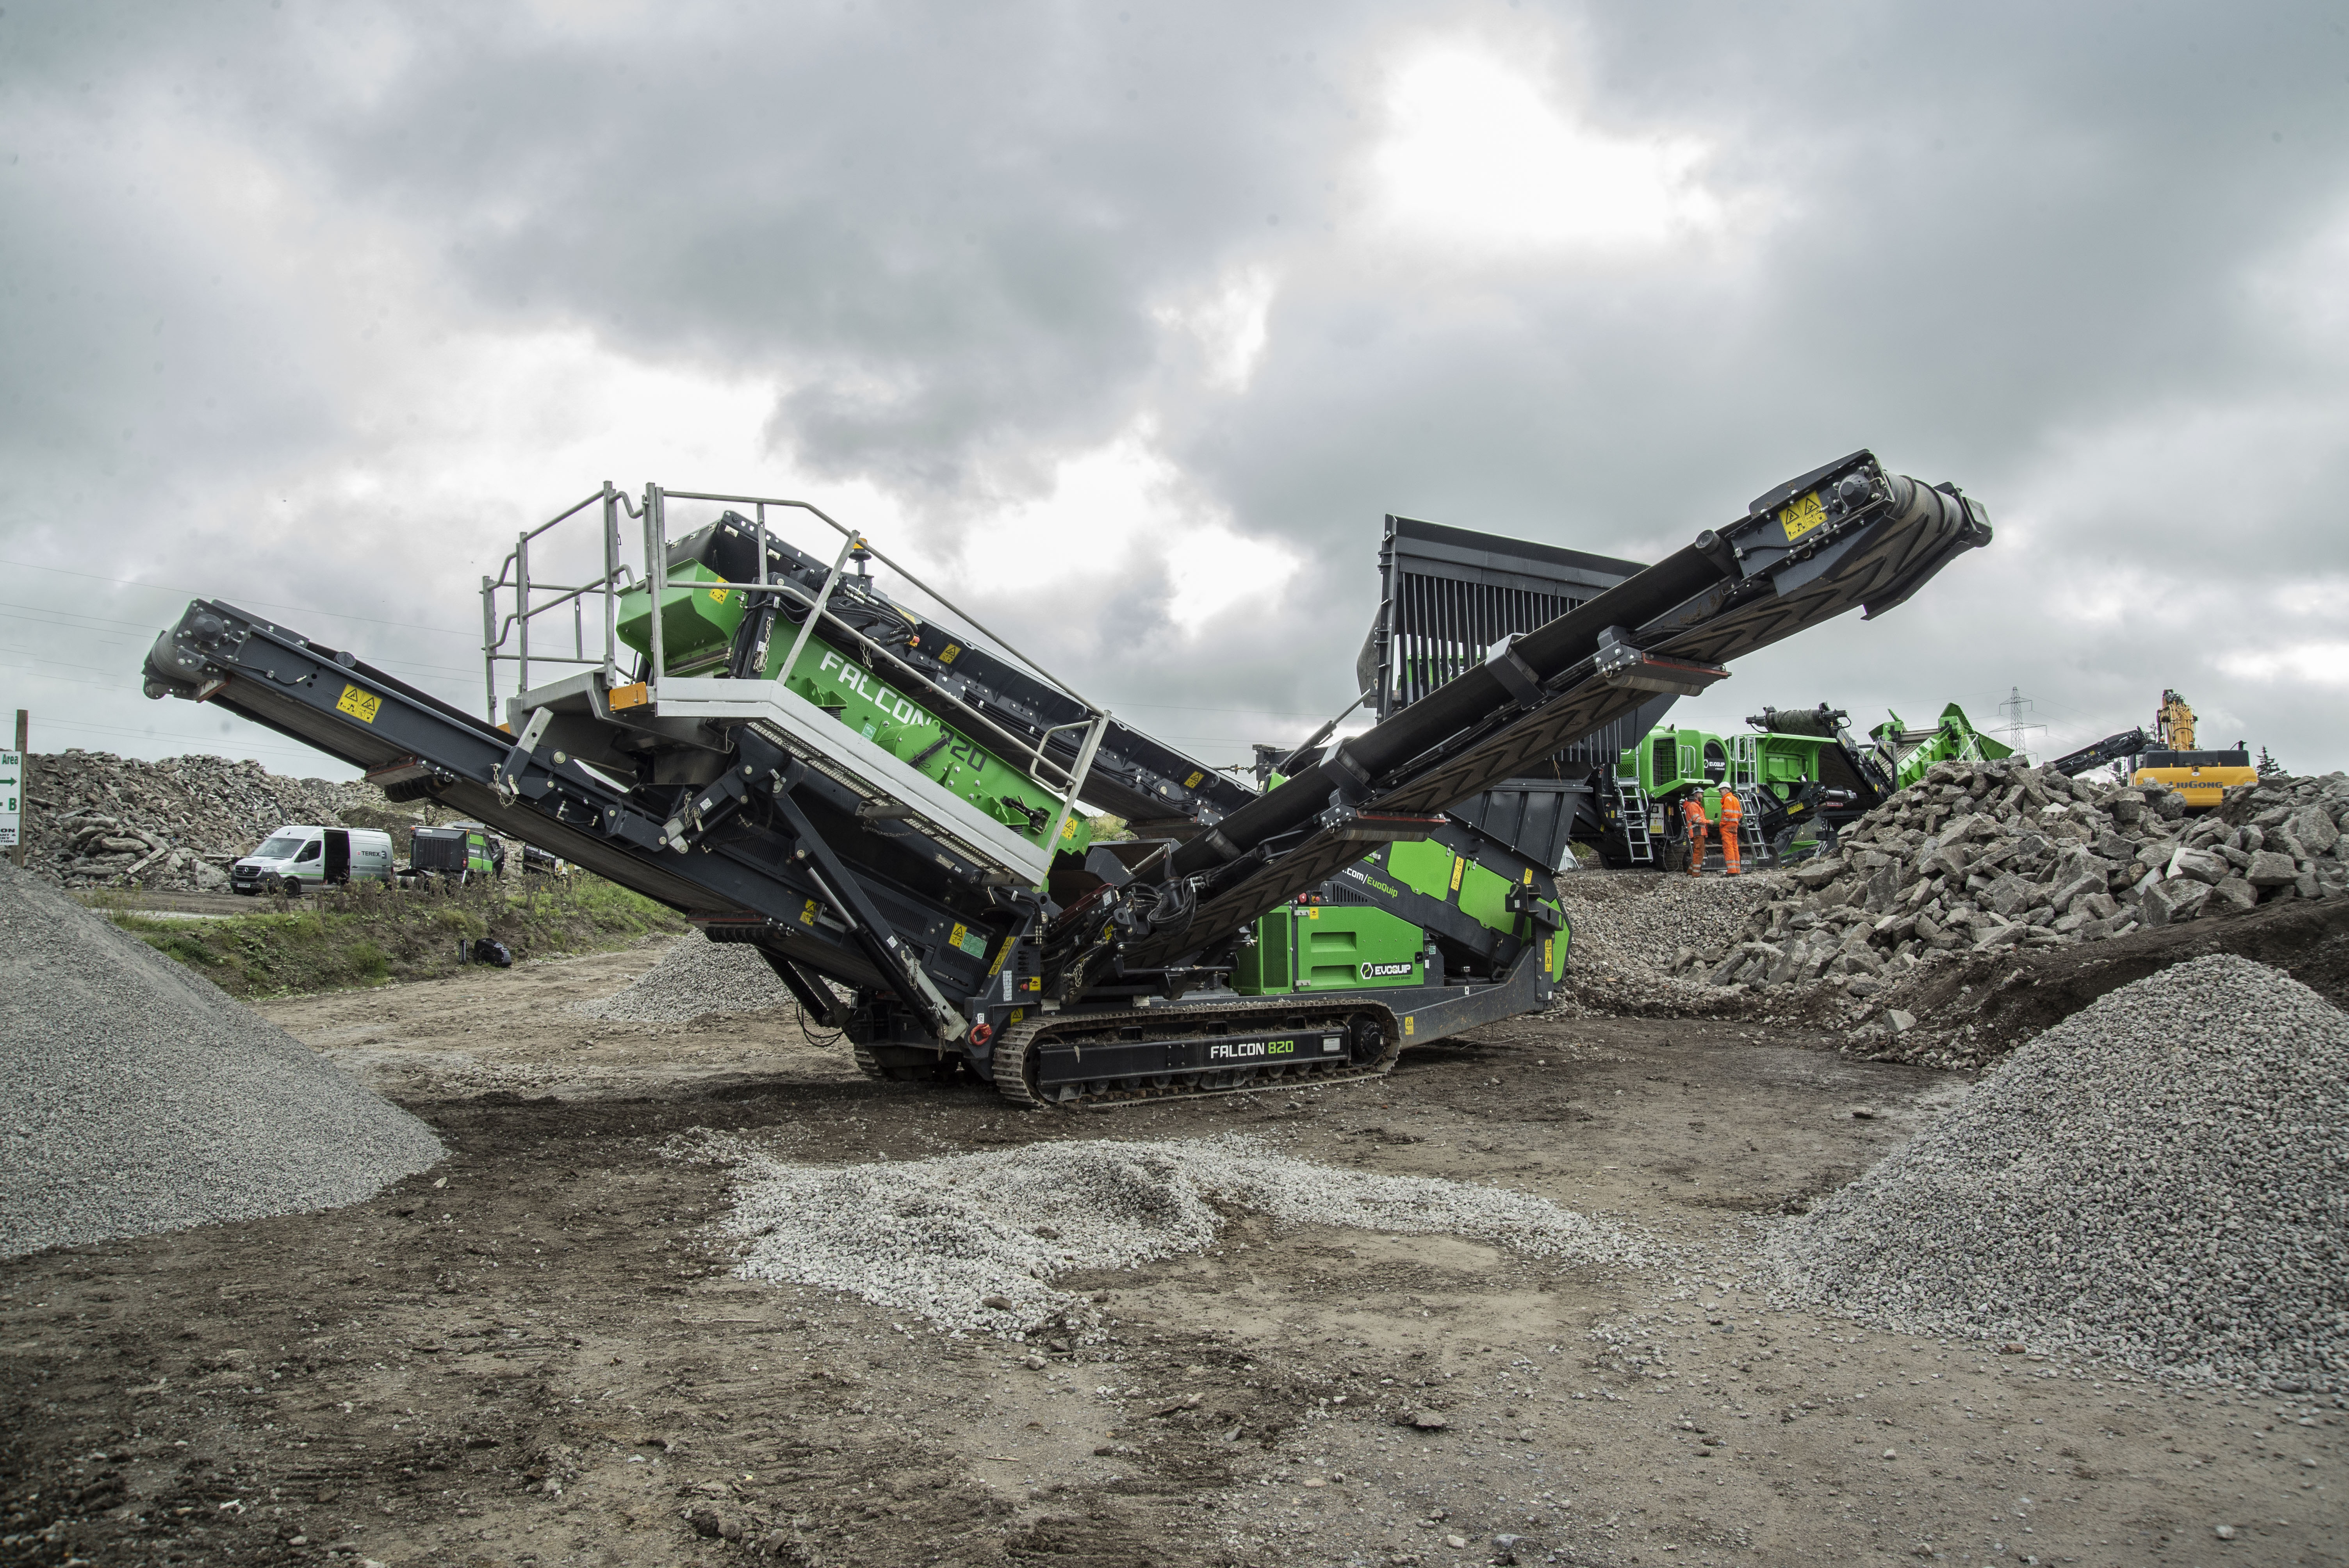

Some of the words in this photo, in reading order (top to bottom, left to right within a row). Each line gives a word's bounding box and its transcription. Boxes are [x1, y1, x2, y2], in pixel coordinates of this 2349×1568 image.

[820, 651, 932, 725] FALCON
[2, 754, 18, 764] Area
[9, 798, 17, 811] B
[1375, 964, 1411, 975] EVOQUIP
[1211, 1042, 1264, 1058] FALCON
[1268, 1041, 1294, 1054] 820
